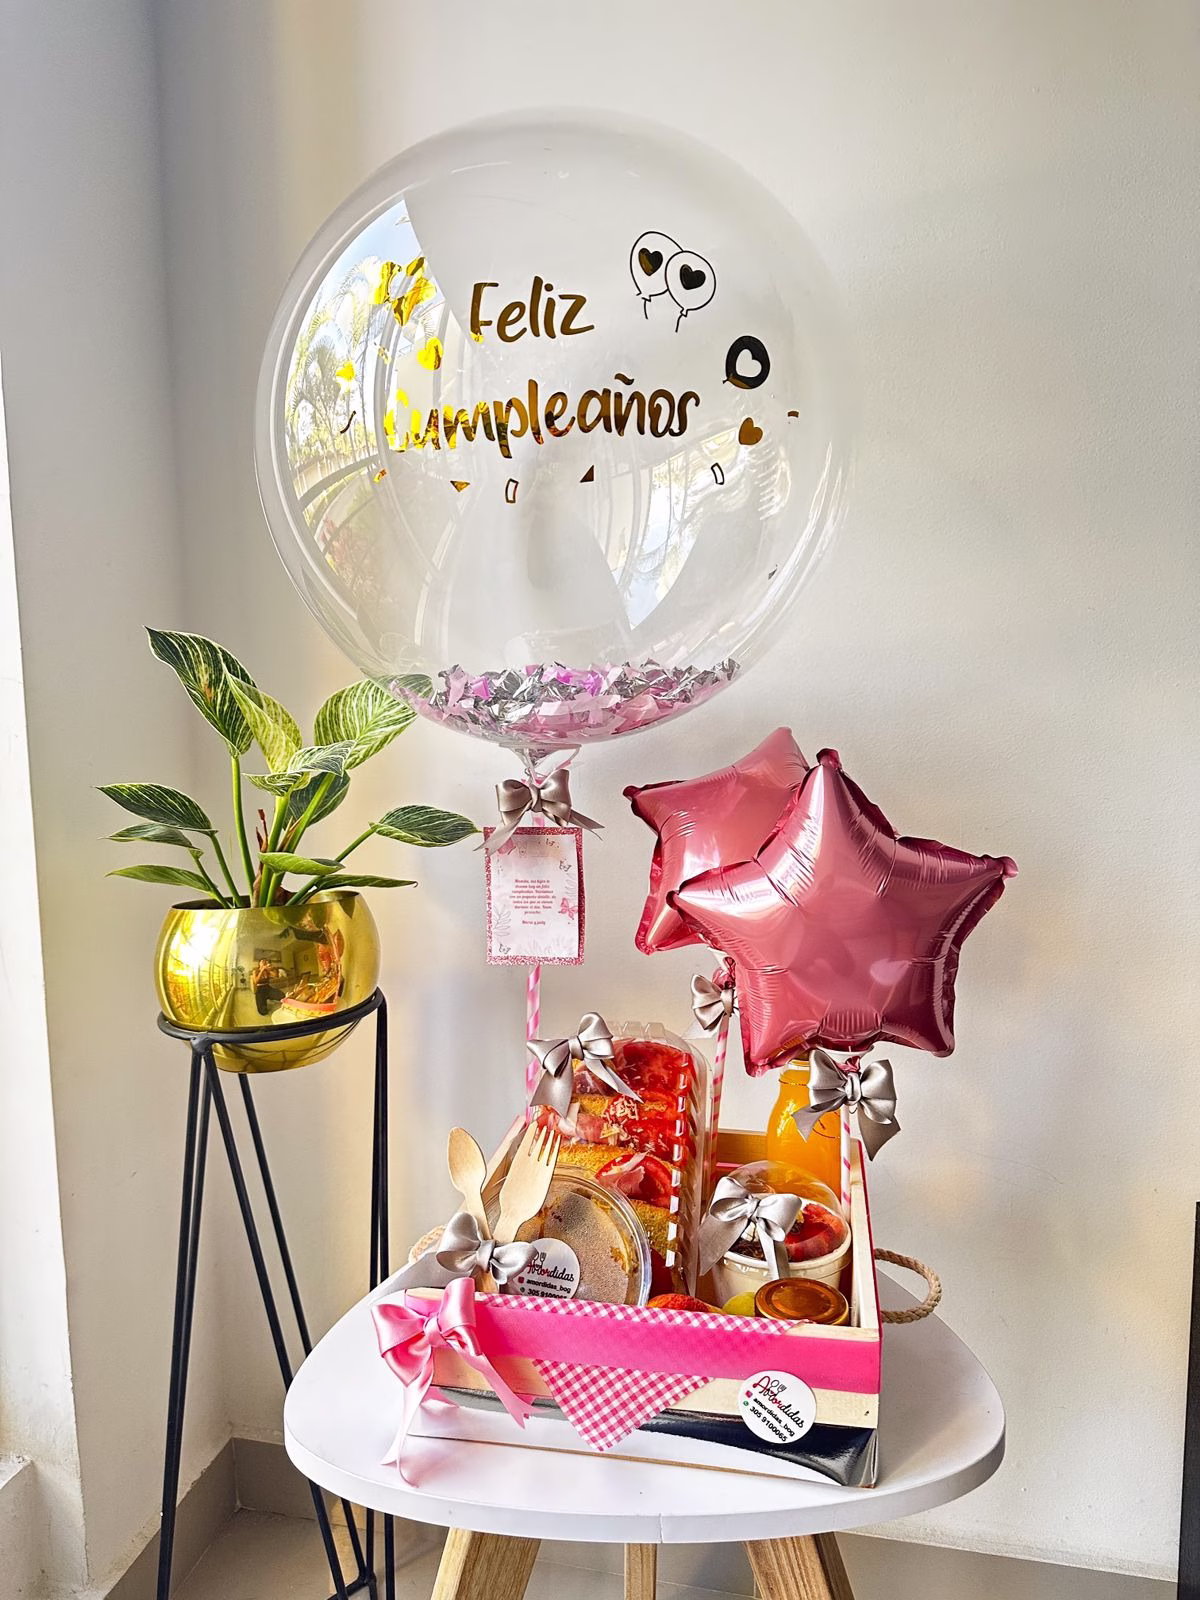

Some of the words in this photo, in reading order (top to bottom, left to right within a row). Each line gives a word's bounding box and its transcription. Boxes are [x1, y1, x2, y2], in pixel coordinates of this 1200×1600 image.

[470, 276, 595, 343] Feliz
[384, 373, 700, 459] Cumpleaños
[527, 1279, 571, 1293] amordidas_bog
[528, 1288, 539, 1296] 305
[750, 1406, 762, 1418] 305
[762, 1417, 787, 1441] 9100065
[753, 1398, 795, 1436] amordidas_bog
